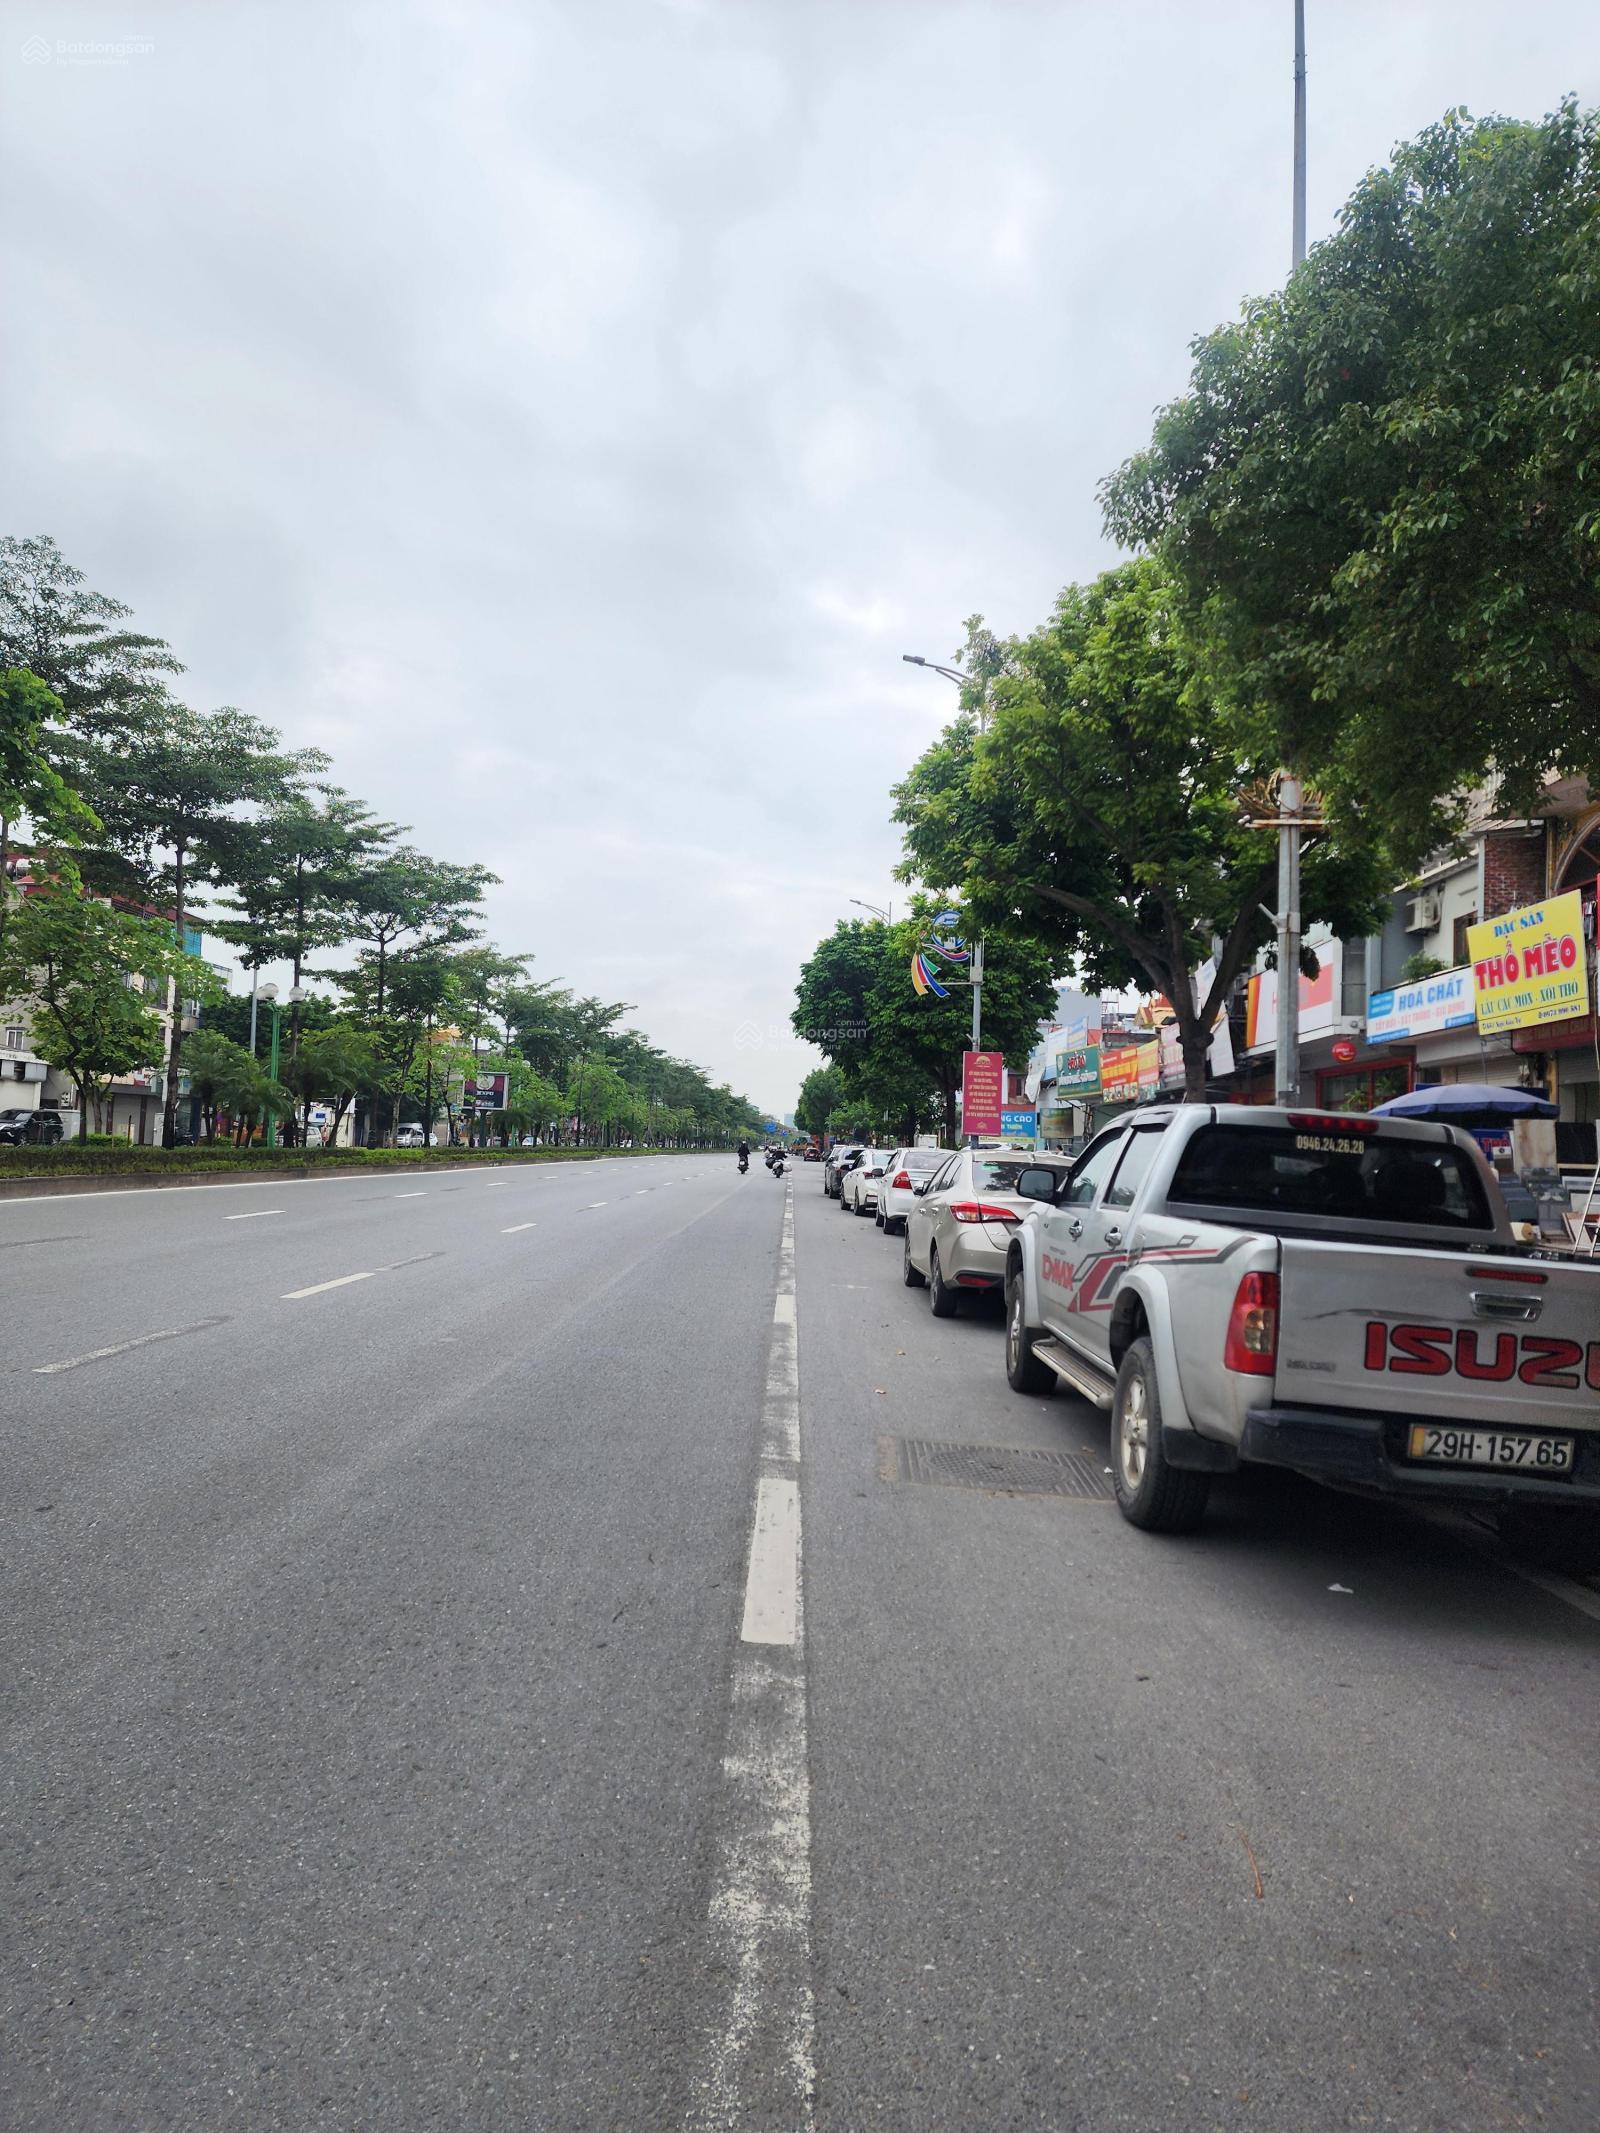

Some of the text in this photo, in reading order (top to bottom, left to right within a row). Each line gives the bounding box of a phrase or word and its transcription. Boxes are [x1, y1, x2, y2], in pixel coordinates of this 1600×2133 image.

[1474, 940, 1520, 990] THỎ
[1427, 975, 1464, 1003] CHẤT
[1364, 1321, 1600, 1391] ISUZ
[1425, 1429, 1569, 1468] 29H-157.65
